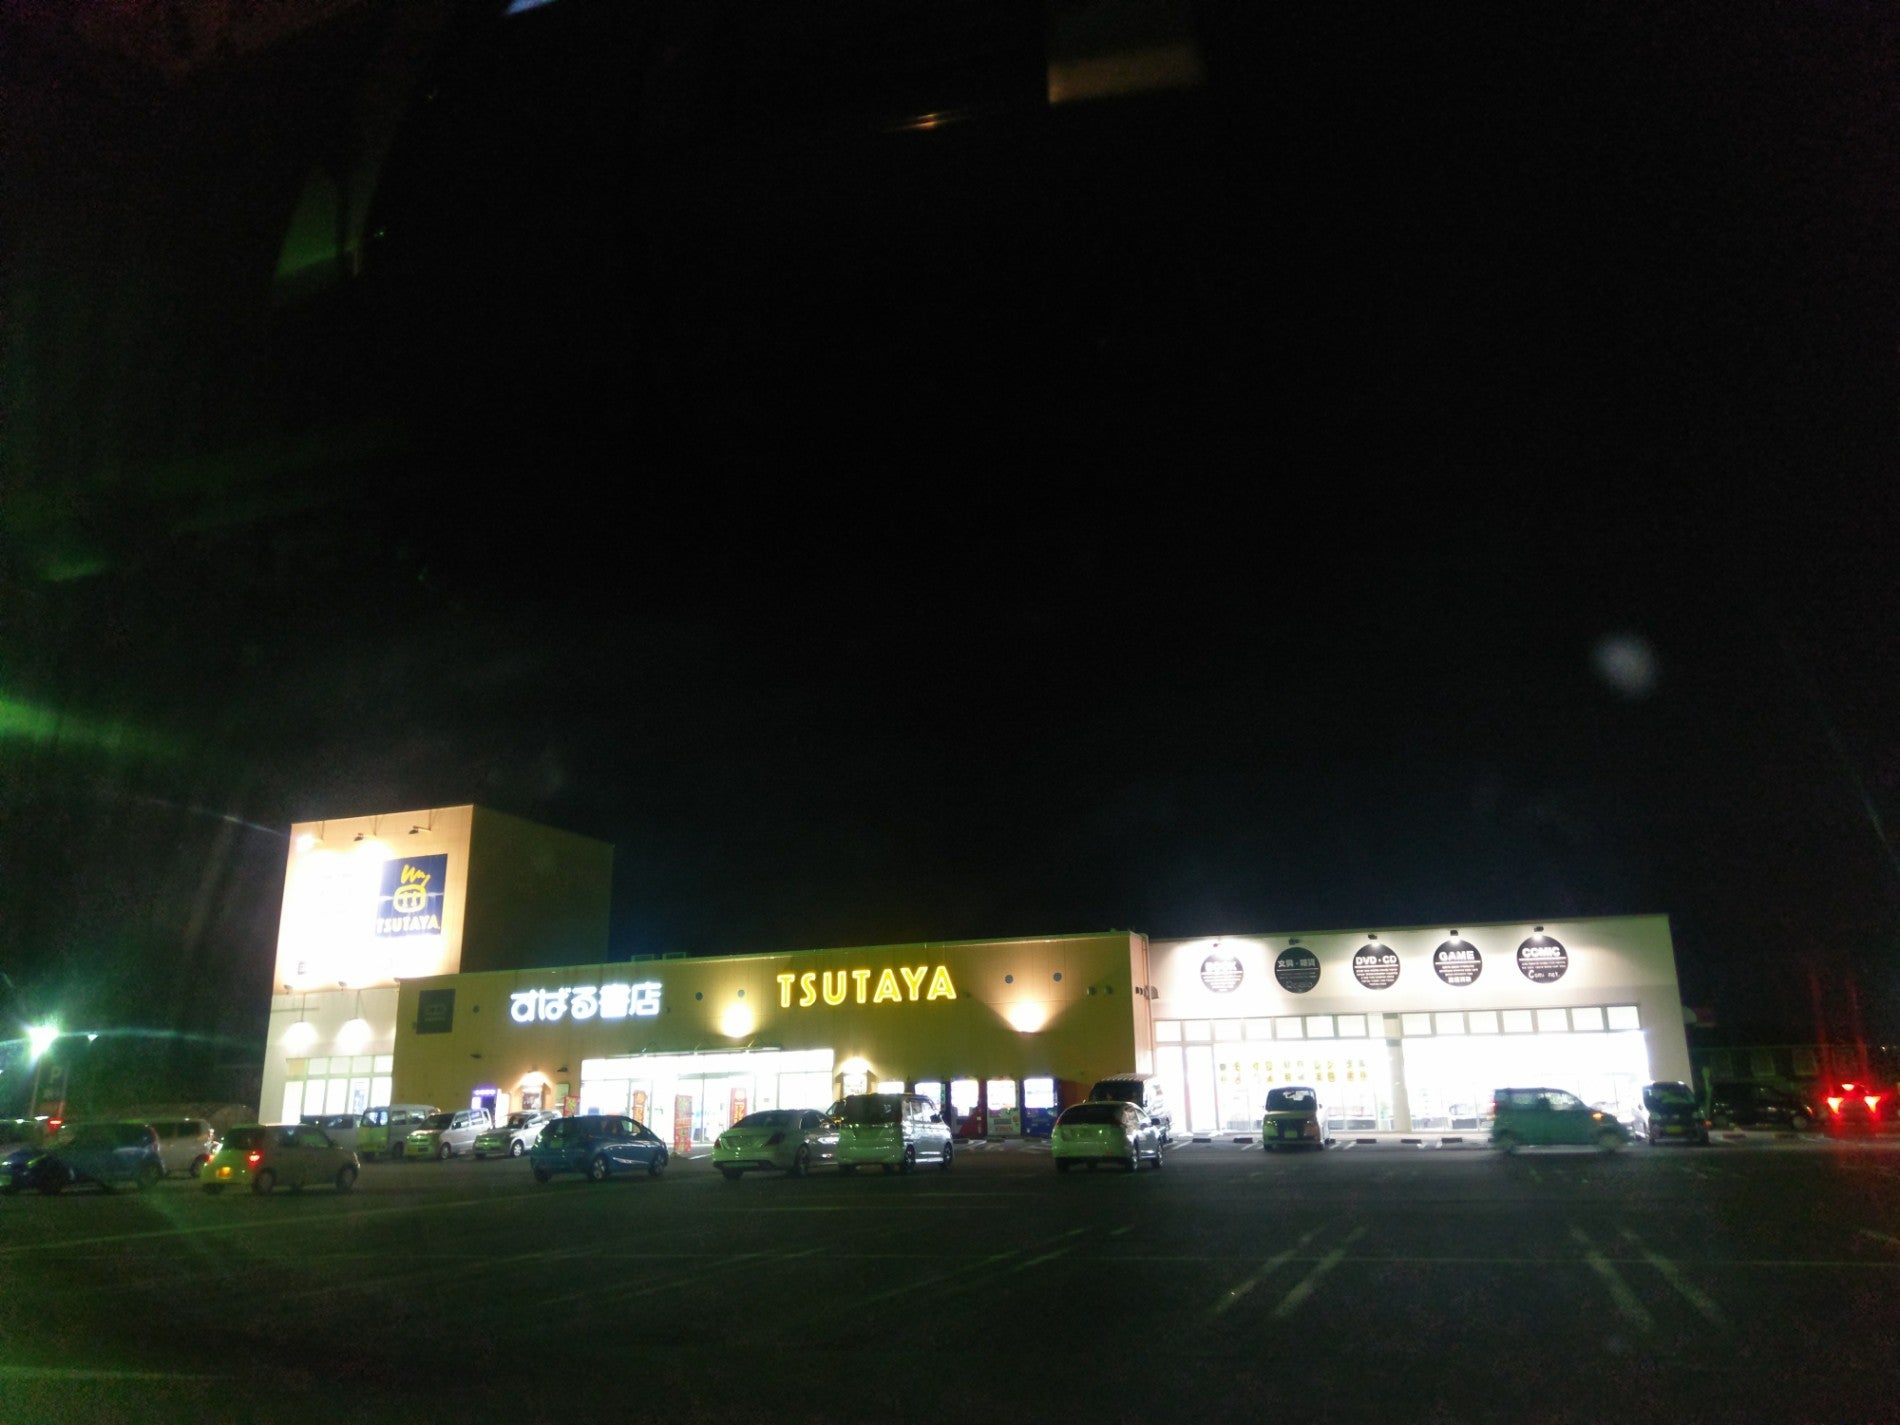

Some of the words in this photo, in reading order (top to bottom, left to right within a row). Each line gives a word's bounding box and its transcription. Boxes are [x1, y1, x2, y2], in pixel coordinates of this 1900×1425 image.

[377, 914, 440, 933] TSUTAYA
[1439, 951, 1475, 962] GAME
[1522, 947, 1561, 958] COMIC
[777, 966, 957, 1008] TSUTAYA
[510, 981, 662, 1023] すばる書店
